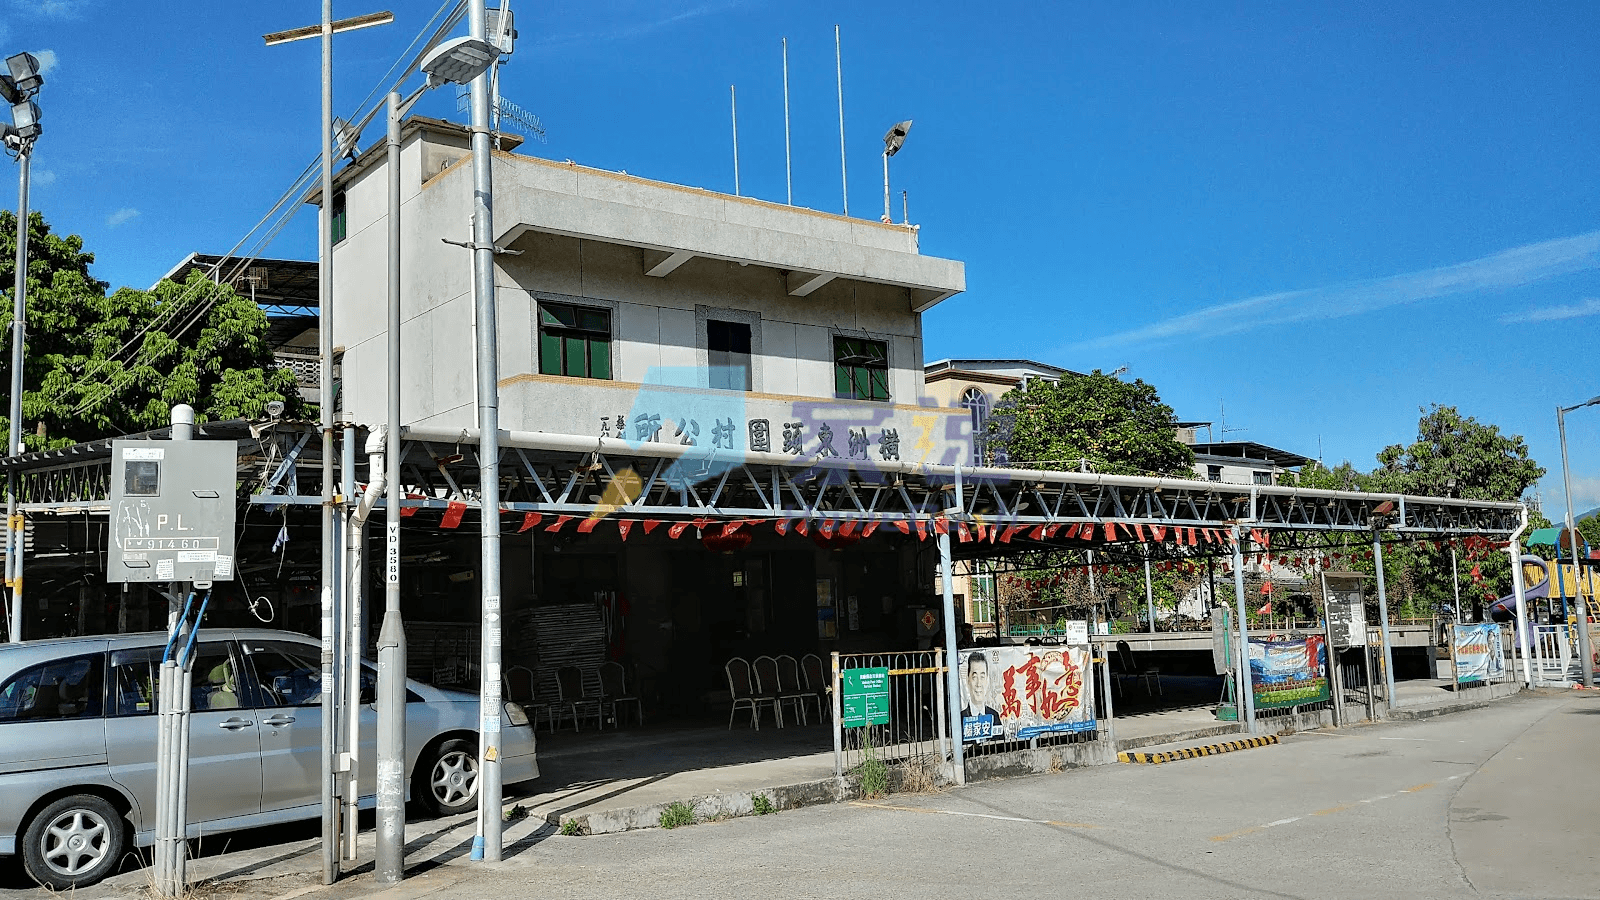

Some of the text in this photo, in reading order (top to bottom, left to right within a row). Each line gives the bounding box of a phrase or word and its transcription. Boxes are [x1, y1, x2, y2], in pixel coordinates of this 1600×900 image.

[157, 513, 194, 531] P.L.
[147, 539, 200, 549] 91460
[389, 526, 398, 582] VD 3580
